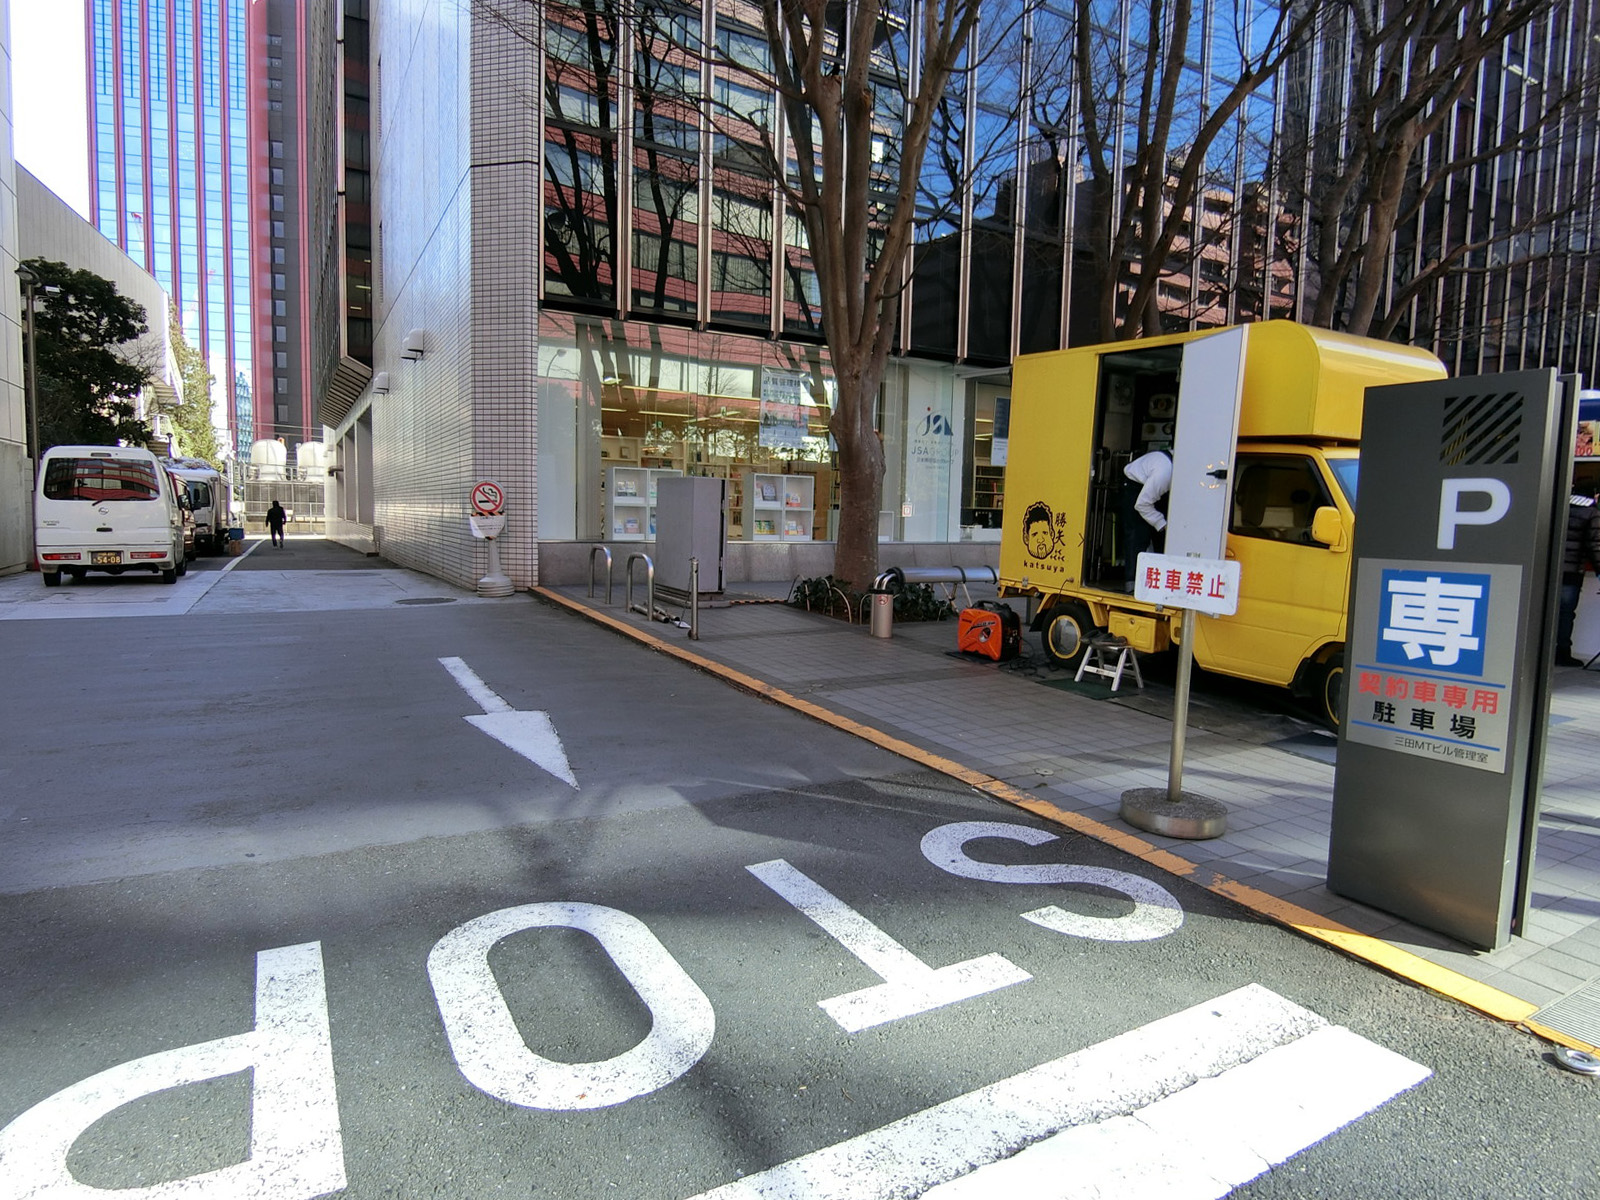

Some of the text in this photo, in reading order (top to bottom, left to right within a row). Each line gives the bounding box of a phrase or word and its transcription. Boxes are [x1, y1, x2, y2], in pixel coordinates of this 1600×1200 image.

[1437, 477, 1511, 550] P
[1023, 560, 1065, 573] katsuya
[1144, 567, 1225, 599] 駐車禁止
[1382, 576, 1483, 666] 専
[1358, 672, 1499, 715] 契約車専用
[1372, 700, 1477, 739] 駐車場
[1394, 736, 1489, 764] 三田MTビル管理室
[0, 821, 1184, 1200] STOP
